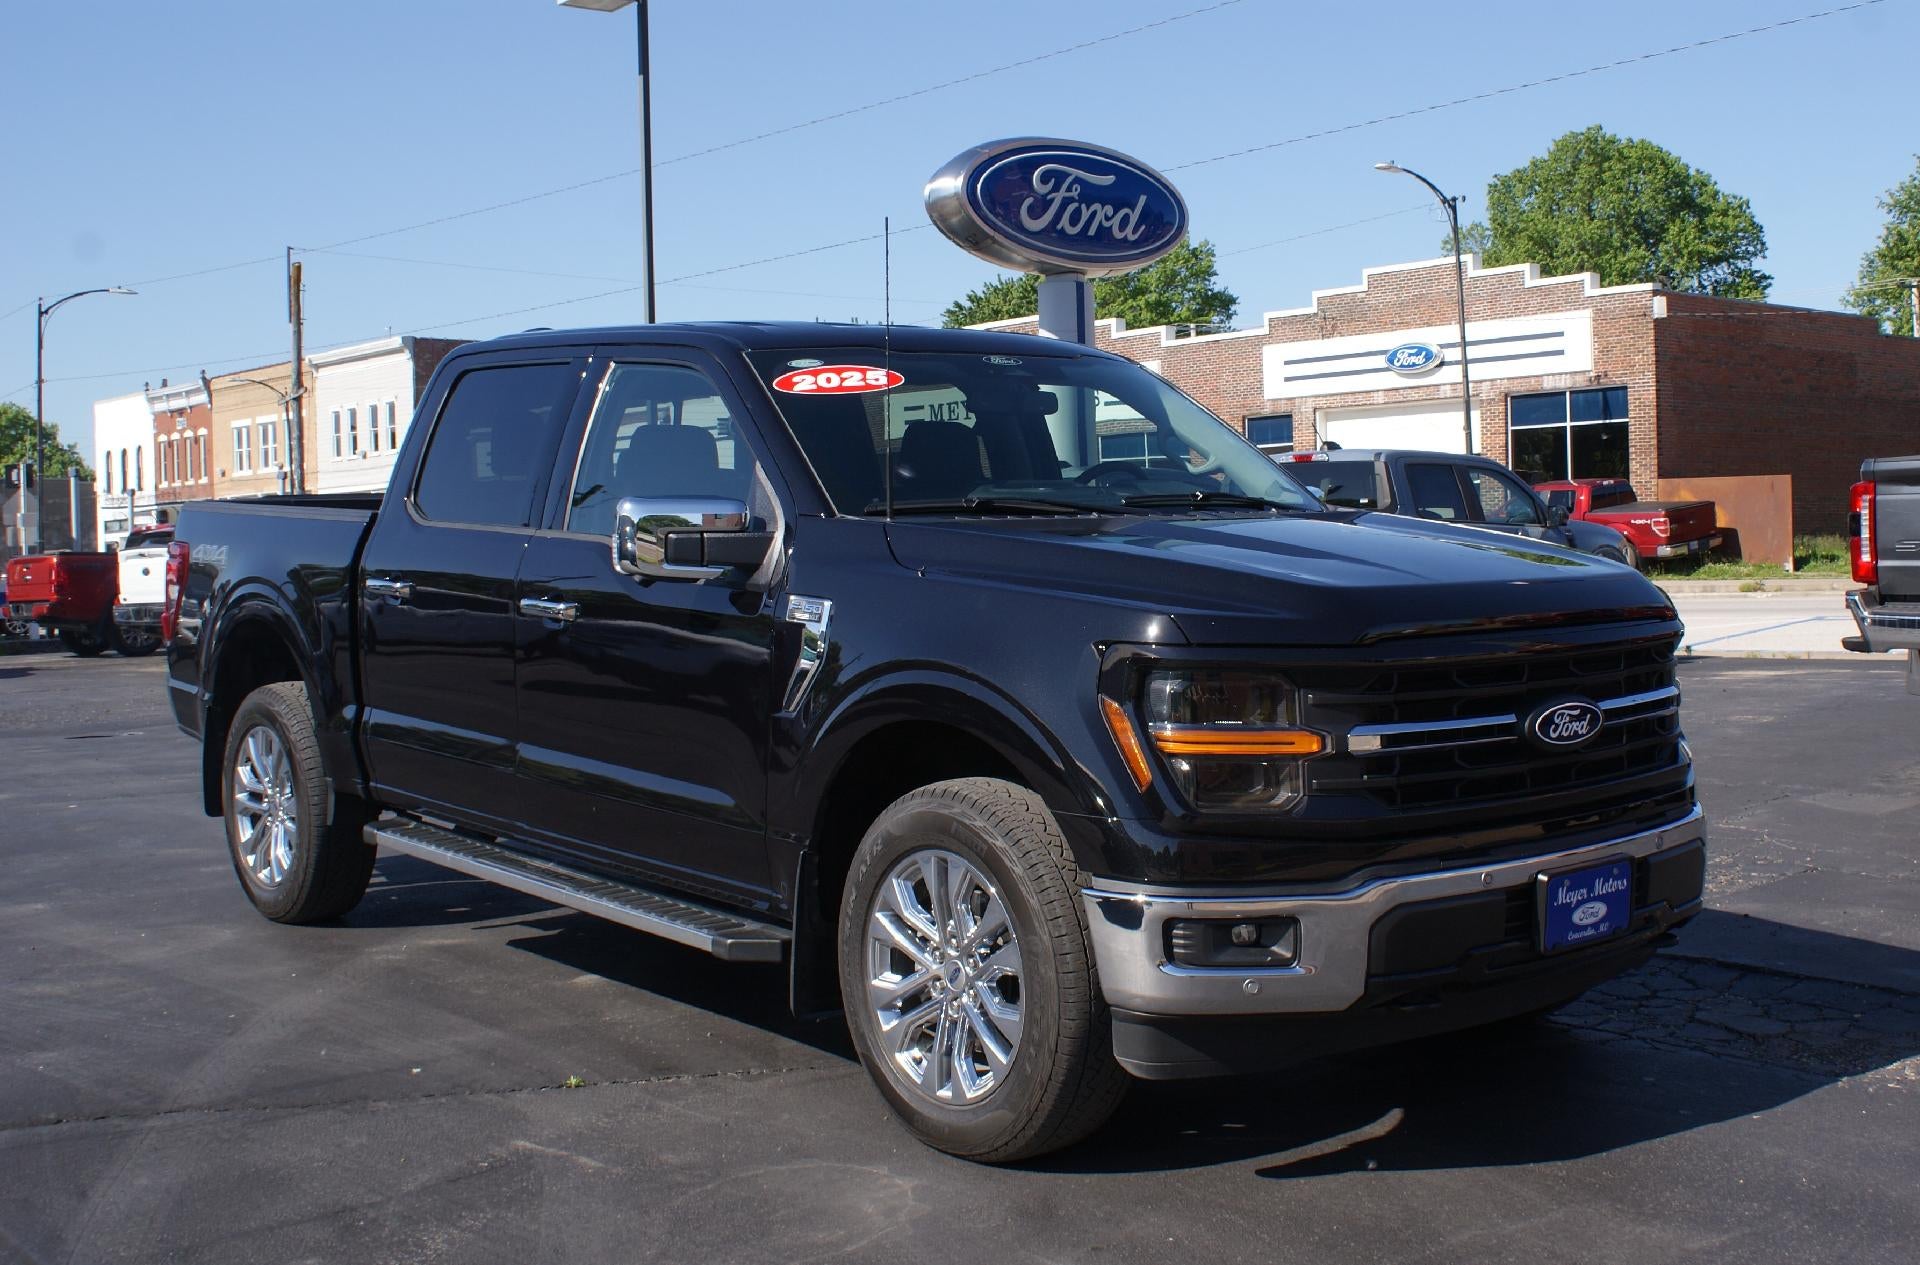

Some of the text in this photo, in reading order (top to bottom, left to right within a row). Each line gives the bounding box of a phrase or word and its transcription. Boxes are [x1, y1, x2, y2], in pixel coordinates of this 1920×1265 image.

[1020, 163, 1147, 241] Ford
[1393, 348, 1427, 367] Ford
[791, 370, 888, 392] 2025
[1549, 709, 1591, 738] Ford
[1553, 877, 1627, 908] Meyer Motors
[1578, 904, 1601, 921] Ford
